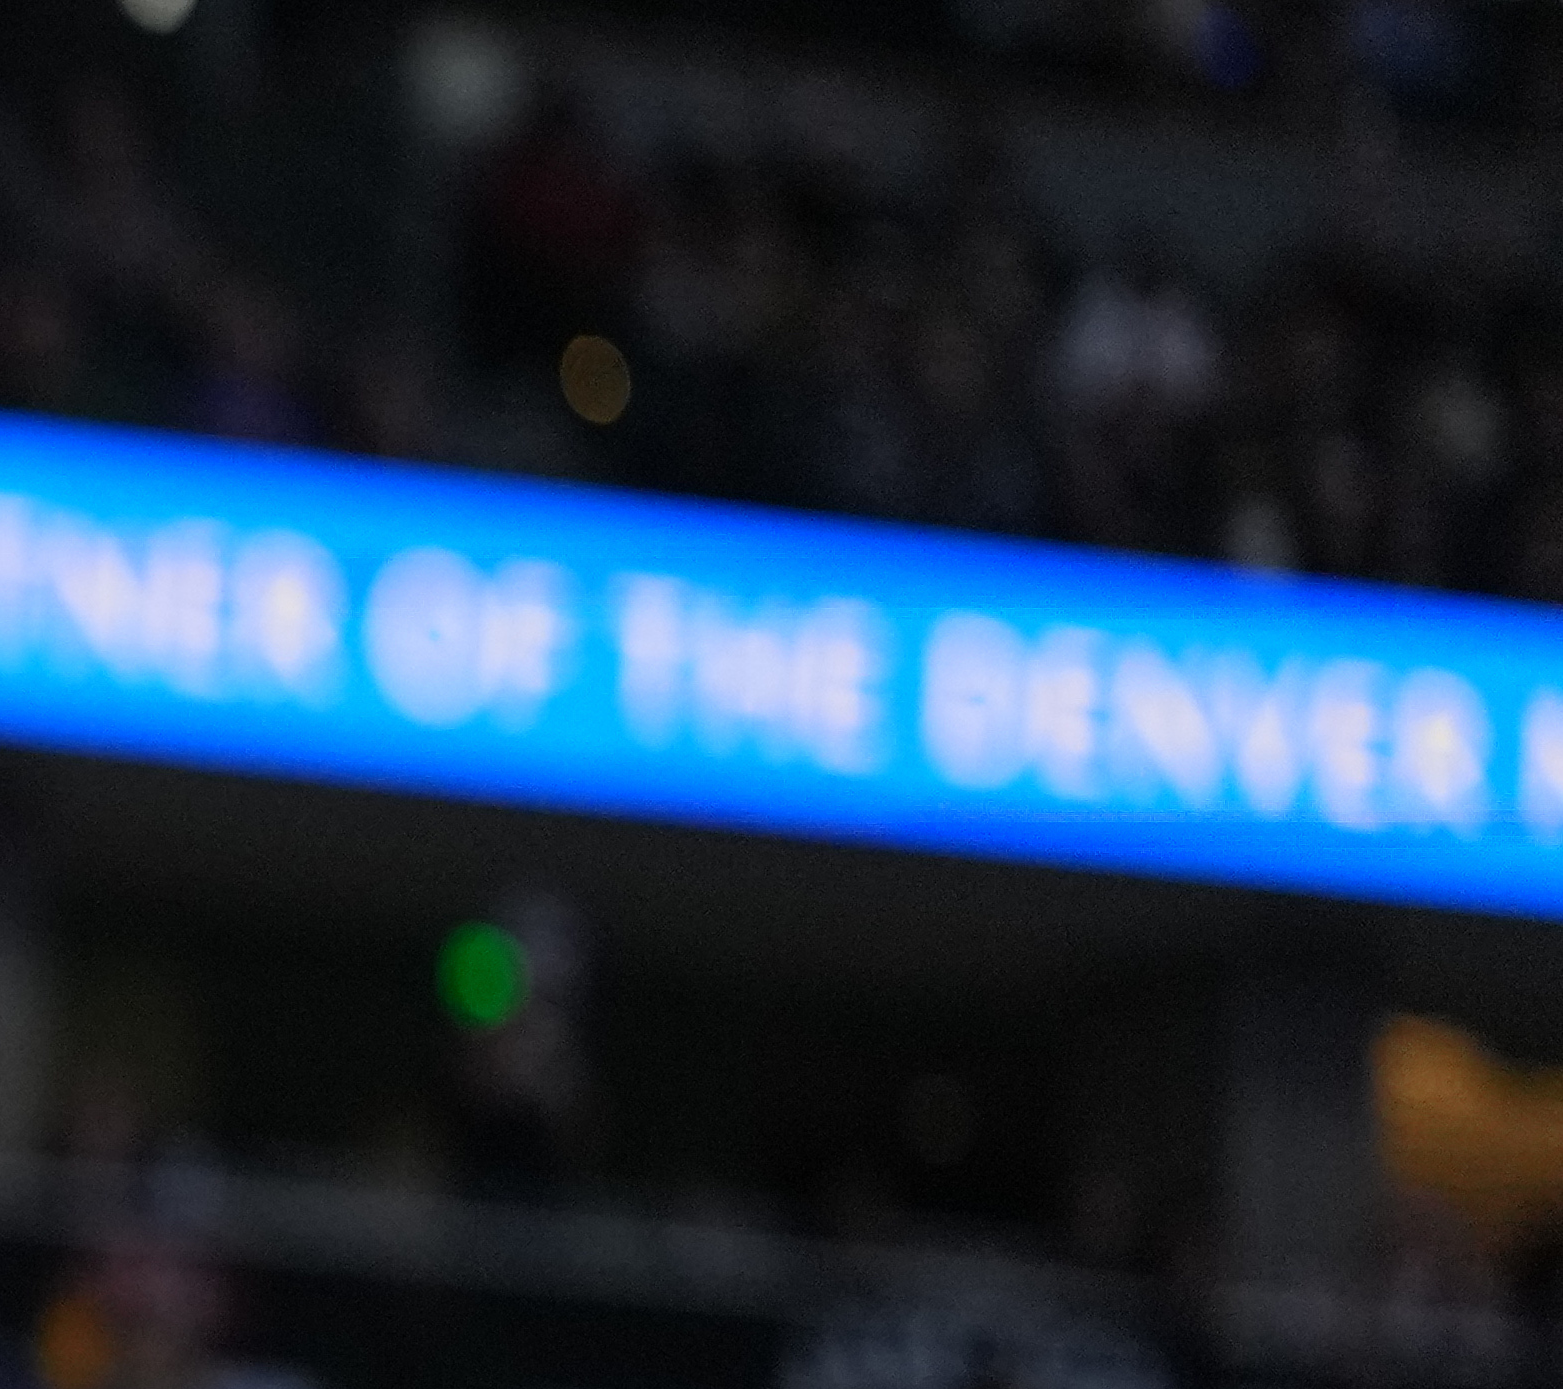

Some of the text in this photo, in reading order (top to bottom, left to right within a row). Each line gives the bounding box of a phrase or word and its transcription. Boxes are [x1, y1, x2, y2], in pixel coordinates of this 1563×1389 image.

[366, 548, 577, 727] OF
[611, 572, 896, 772] THE
[921, 612, 1498, 838] DENVER
